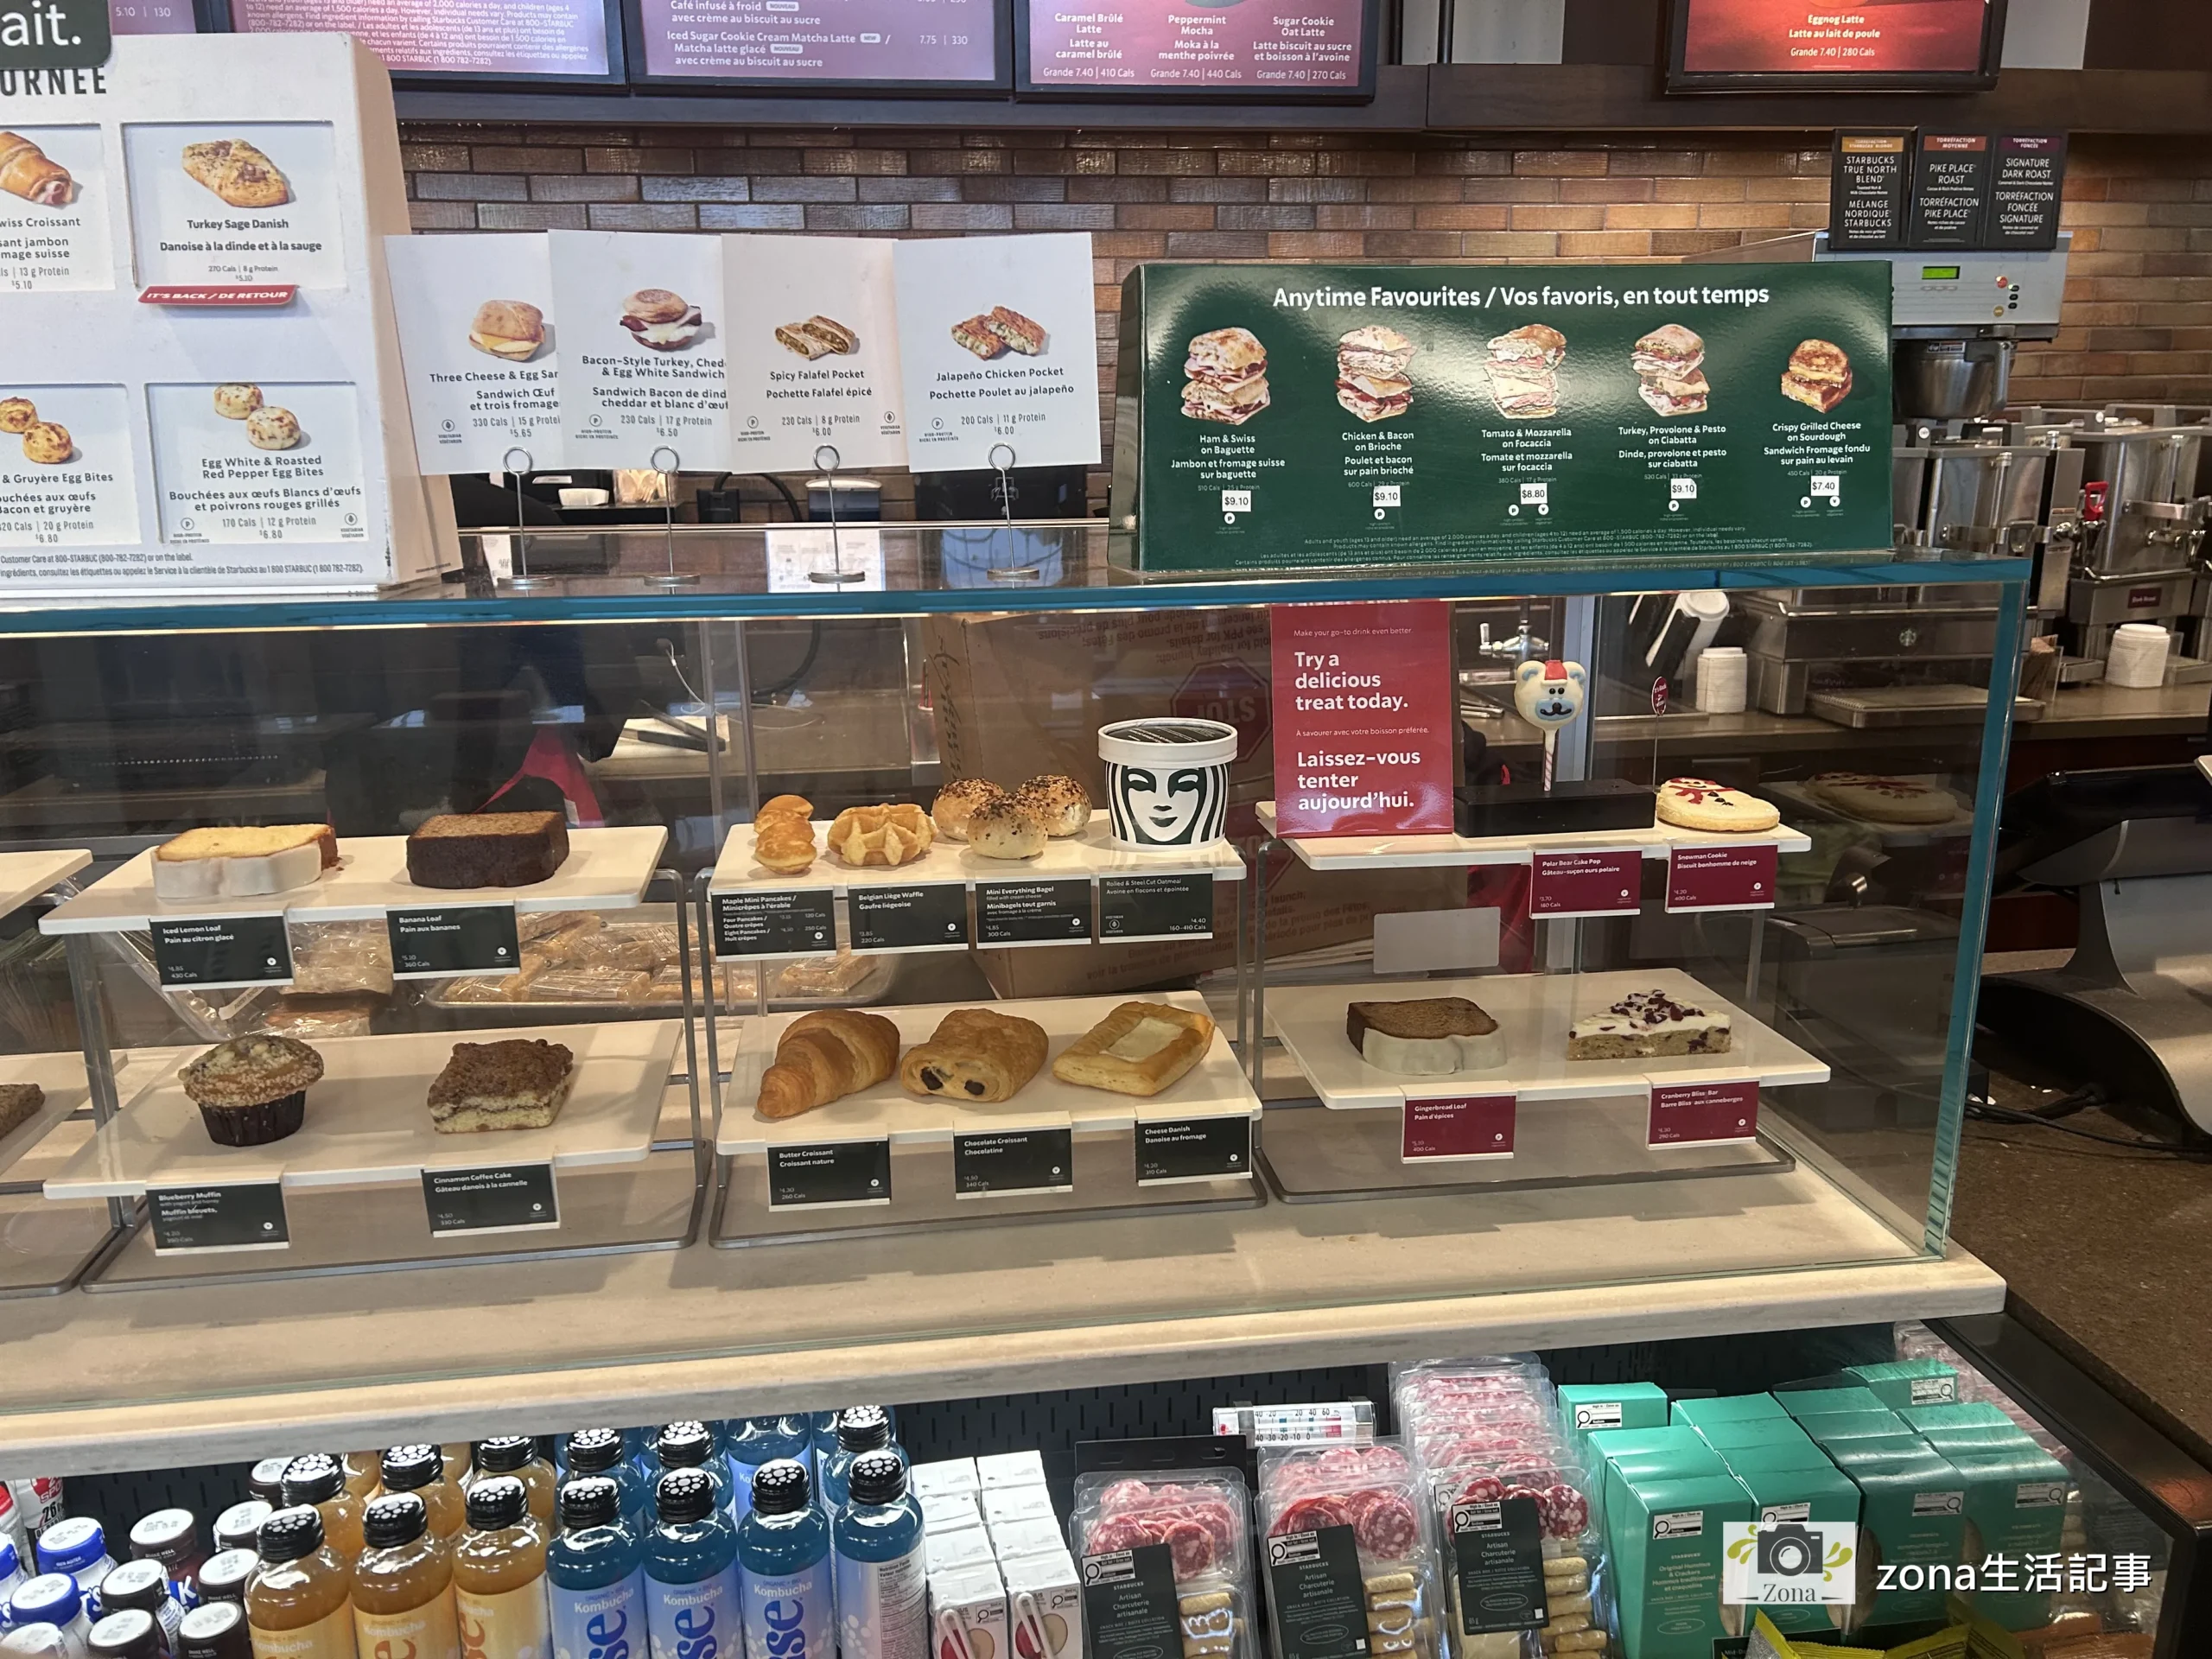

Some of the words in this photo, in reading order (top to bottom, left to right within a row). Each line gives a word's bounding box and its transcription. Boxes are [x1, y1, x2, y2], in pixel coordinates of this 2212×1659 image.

[115, 6, 136, 17] 5.10
[153, 6, 171, 17] 130
[1054, 11, 1096, 22] Caramel
[1096, 13, 1123, 23] Brûlé
[1168, 15, 1225, 28] Peppermint
[1272, 16, 1300, 29] Sugar
[1300, 16, 1334, 26] Cookie
[1807, 13, 1840, 26] Eggnog
[1840, 14, 1865, 24] Latte
[1076, 23, 1103, 34] Latte
[1180, 25, 1213, 35] Mocha
[1281, 26, 1299, 36] Oat
[1300, 27, 1325, 37] Latte
[666, 30, 689, 41] Iced
[690, 30, 719, 43] Sugar
[720, 30, 755, 41] Cookie
[756, 31, 789, 42] Cream
[791, 32, 829, 43] Matcha
[830, 33, 855, 43] Latte
[919, 35, 937, 45] 7.75
[951, 35, 969, 45] 330
[1846, 155, 1895, 165] STARBUCKS
[2005, 156, 2050, 168] SIGNATURE
[1843, 164, 1864, 174] TRUE
[1866, 164, 1897, 174] NORTH
[1929, 162, 1947, 173] PIKE
[2001, 168, 2024, 179] DARK
[2024, 168, 2051, 180] ROAST
[1937, 175, 1965, 185] ROAST
[26, 217, 81, 227] Croissant
[186, 219, 223, 231] Turkey
[224, 219, 251, 232] Sage
[251, 218, 289, 229] Danish
[24, 238, 69, 249] jambon
[35, 247, 70, 258] suisse
[1273, 286, 1365, 311] Anytime
[1371, 285, 1480, 306] Favourites
[1500, 287, 1537, 305] Vos
[1541, 286, 1618, 307] favoris,
[1623, 290, 1648, 304] en
[1653, 287, 1697, 304] tout
[1701, 287, 1769, 307] temps
[582, 354, 651, 367] Bacon-Style
[652, 356, 694, 369] Turkey,
[429, 372, 462, 383] Three
[464, 371, 505, 382] Cheese
[508, 370, 517, 380] &
[519, 370, 539, 382] Egg
[769, 370, 796, 382] Spicy
[798, 369, 830, 380] Falafel
[831, 369, 864, 379] Pocket
[936, 371, 982, 383] Jalapeño
[984, 368, 1026, 379] Chicken
[1028, 366, 1064, 377] Pocket
[1480, 429, 1515, 438] Tomato
[1516, 428, 1523, 437] &
[1524, 427, 1572, 437] Mozzarella
[1618, 425, 1649, 436] Turkey,
[1649, 424, 1693, 435] Provolone
[1693, 424, 1700, 434] &
[1701, 424, 1726, 434] Pesto
[1771, 423, 1799, 433] Crispy
[1799, 421, 1828, 431] Grilled
[1829, 421, 1861, 430] Cheese
[1199, 434, 1221, 443] Ham
[1221, 434, 1230, 443] &
[1230, 433, 1255, 443] Swiss
[1341, 431, 1376, 441] Chicken
[1377, 431, 1386, 441] &
[1386, 430, 1414, 440] Bacon
[1660, 435, 1697, 445] Ciabatta
[1799, 431, 1846, 442] Sourdough
[1367, 441, 1402, 451] Brioche
[1515, 437, 1552, 448] Focaccia
[1213, 445, 1255, 456] Baguette
[201, 457, 222, 470] Egg
[224, 456, 261, 467] White
[263, 456, 272, 467] &
[275, 454, 321, 466] Roasted
[201, 468, 225, 479] Red
[227, 468, 269, 480] Pepper
[271, 467, 292, 480] Egg
[294, 467, 324, 477] Bites
[1330, 629, 1351, 638] go-to
[1294, 652, 1324, 670] Try
[1327, 653, 1339, 667] a
[1295, 671, 1380, 689] delicious
[1295, 696, 1344, 710] treat
[1347, 693, 1408, 711] today.
[1298, 750, 1420, 766] Laissez-vous
[1298, 773, 1357, 788] tenter
[1001, 887, 1036, 896] Everything
[1035, 885, 1054, 893] Bagel
[858, 893, 884, 902] Belgian
[162, 926, 179, 935] Iced
[204, 924, 221, 932] Loaf
[1414, 1103, 1453, 1113] Gingerbread
[1167, 1125, 1191, 1134] Danish
[963, 1139, 997, 1147] Chocolate
[996, 1136, 1027, 1145] Croissant
[801, 1148, 834, 1157] Croissant
[433, 1175, 470, 1184] Cinnamon
[1113, 1580, 1145, 1591] STARBUCKS
[1118, 1592, 1142, 1602] Artisan
[1112, 1599, 1150, 1611] Charcuterie
[1116, 1607, 1148, 1618] artisanale
